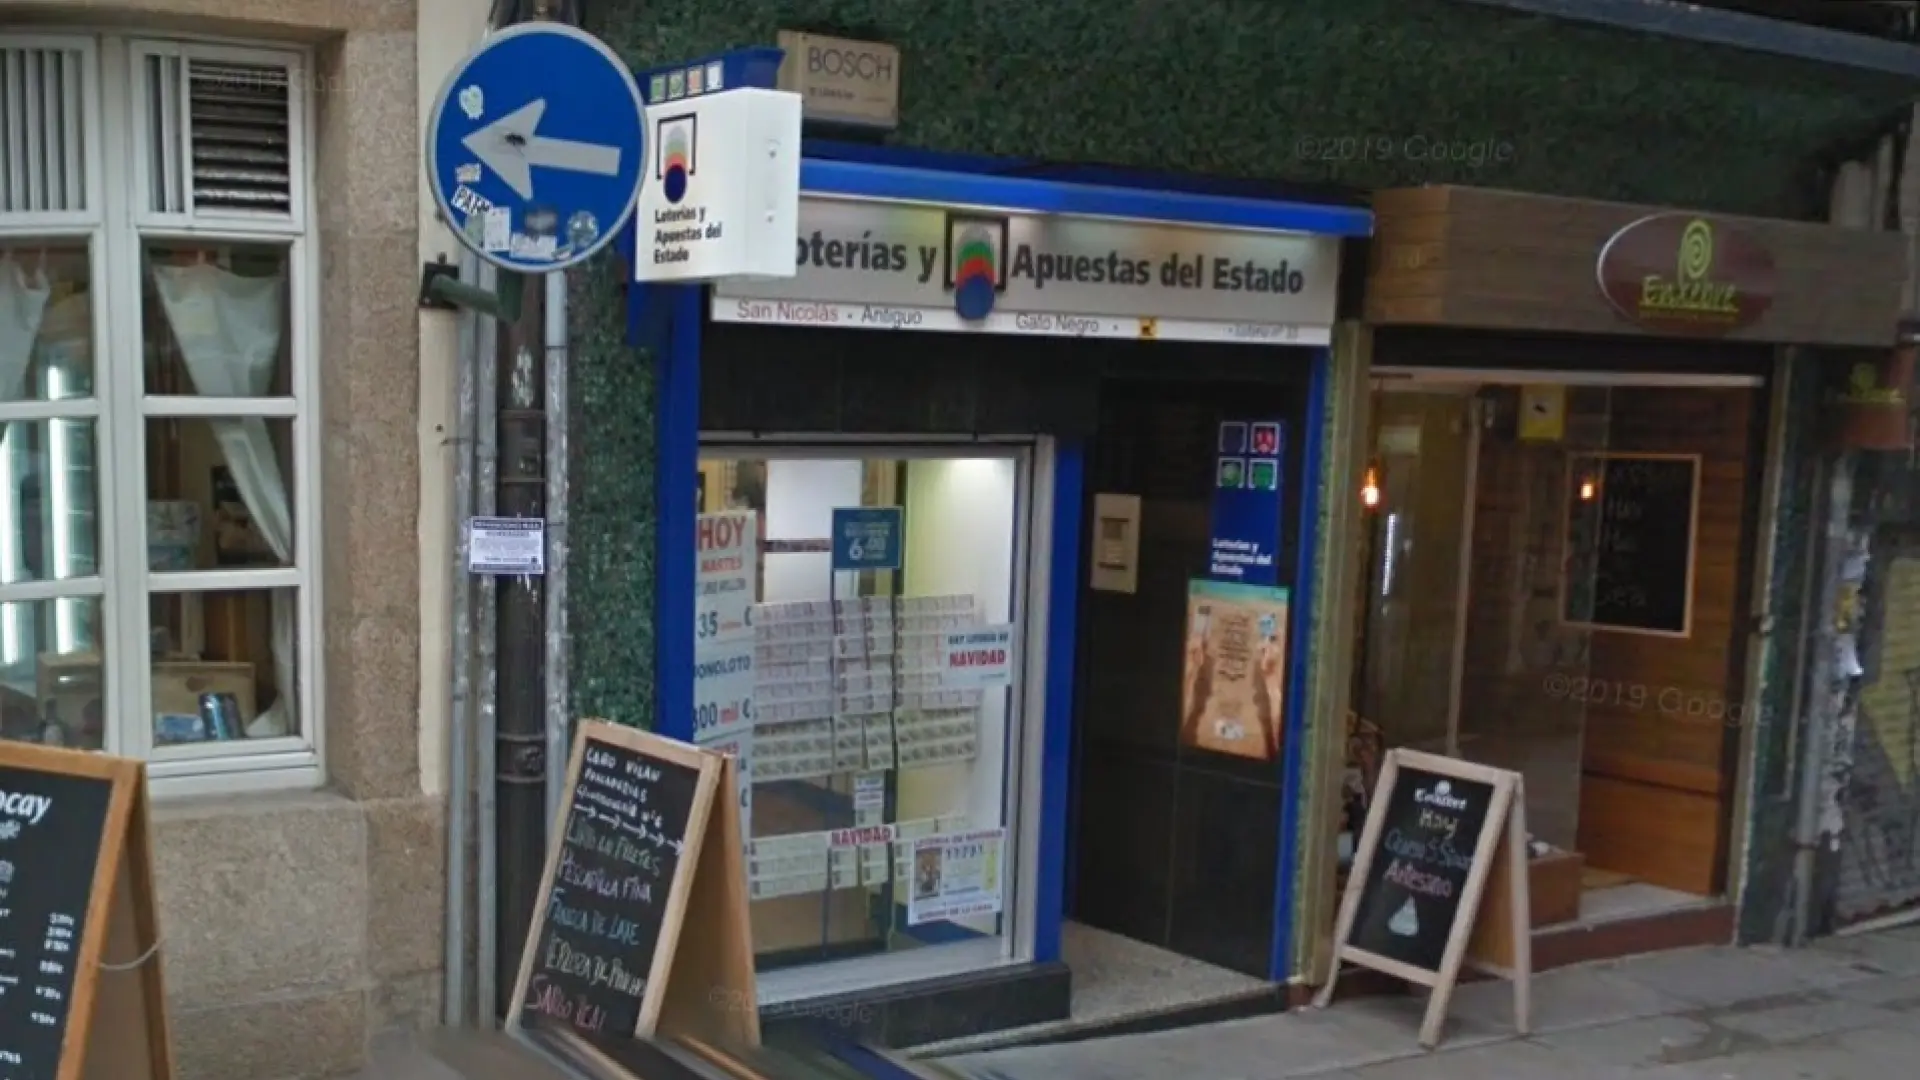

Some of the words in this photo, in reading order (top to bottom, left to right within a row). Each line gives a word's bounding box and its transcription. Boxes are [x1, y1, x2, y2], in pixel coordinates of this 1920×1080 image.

[807, 45, 892, 81] BOSCH
[796, 230, 907, 271] oterías
[917, 243, 937, 283] y
[1011, 244, 1150, 289] Apuestas
[1159, 252, 1203, 289] del
[1213, 257, 1304, 294] Estado
[737, 300, 773, 319] San
[1015, 312, 1051, 330] Gato
[1056, 314, 1100, 336] Negro
[697, 515, 747, 552] HOY
[697, 610, 718, 638] 35
[949, 648, 1006, 669] NAVIDAD
[831, 826, 892, 847] NAVIDAD
[1419, 808, 1459, 841] Hay
